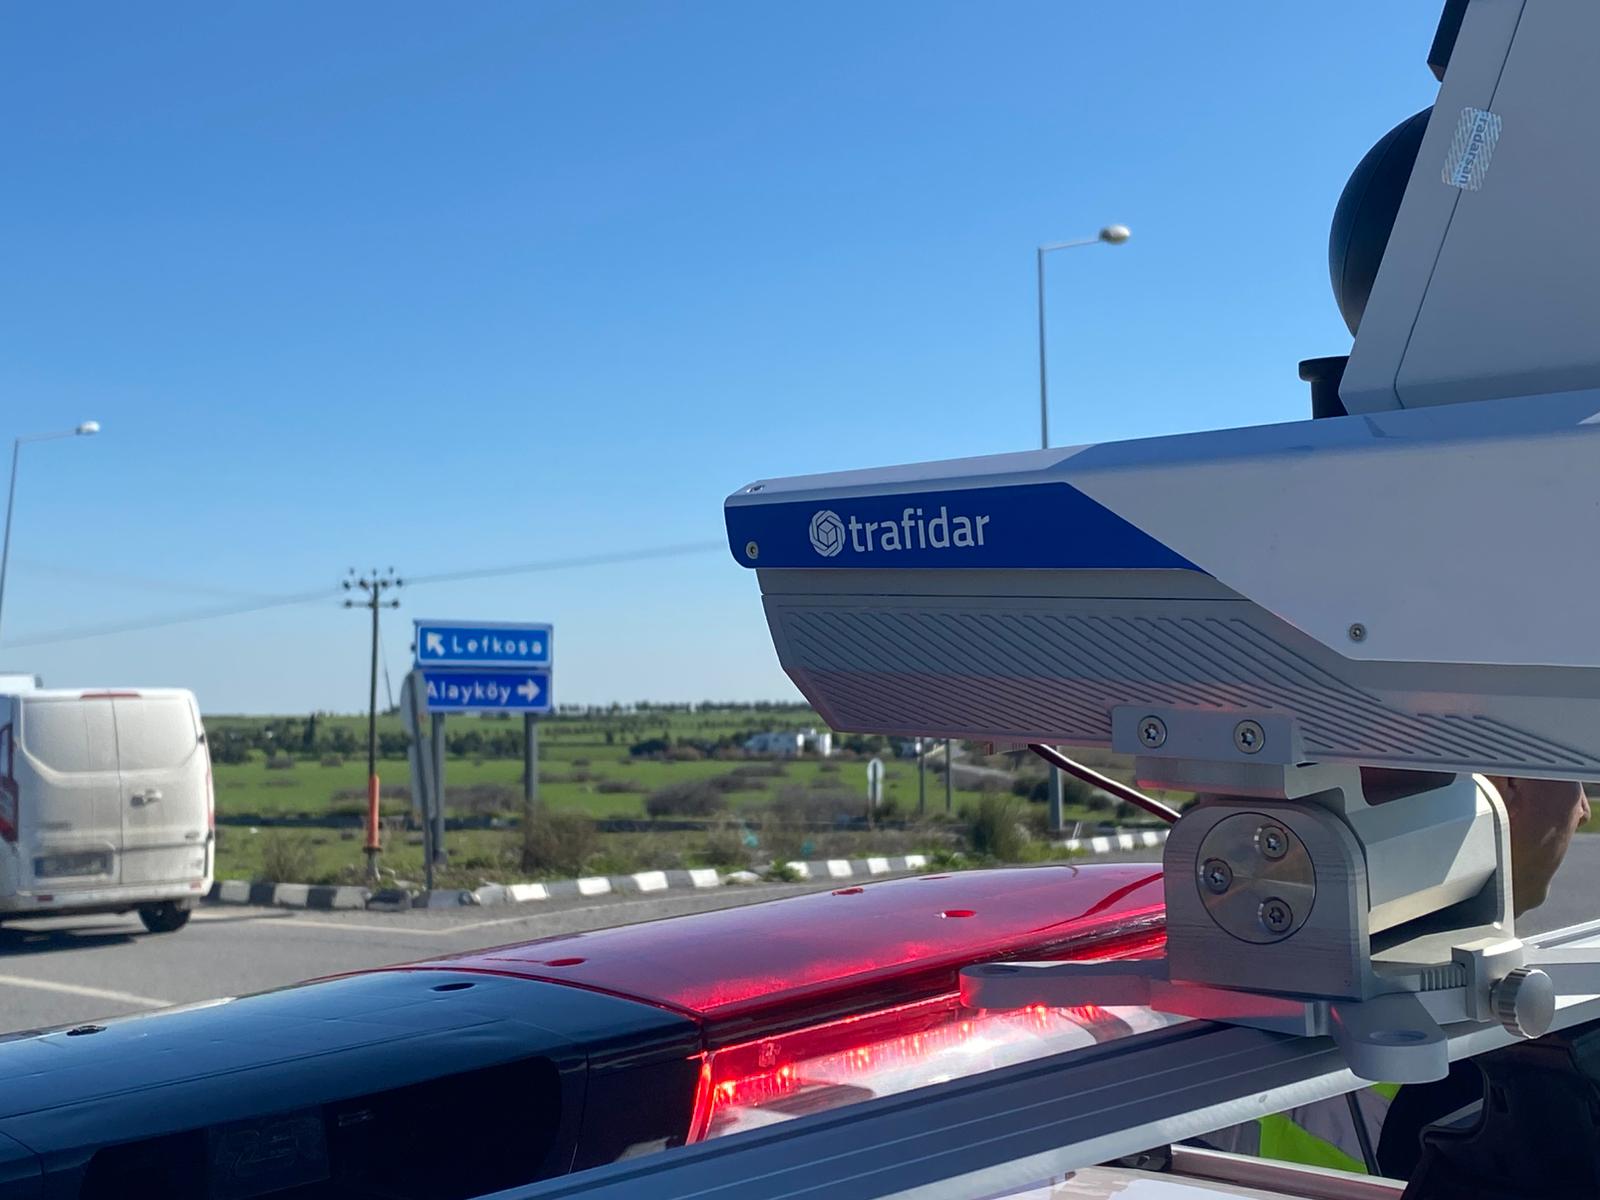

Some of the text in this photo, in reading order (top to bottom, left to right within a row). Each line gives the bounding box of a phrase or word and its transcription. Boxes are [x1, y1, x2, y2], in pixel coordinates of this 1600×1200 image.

[1459, 117, 1487, 184] radarsan
[849, 506, 990, 552] trafidar
[427, 680, 511, 704] Alayköy
